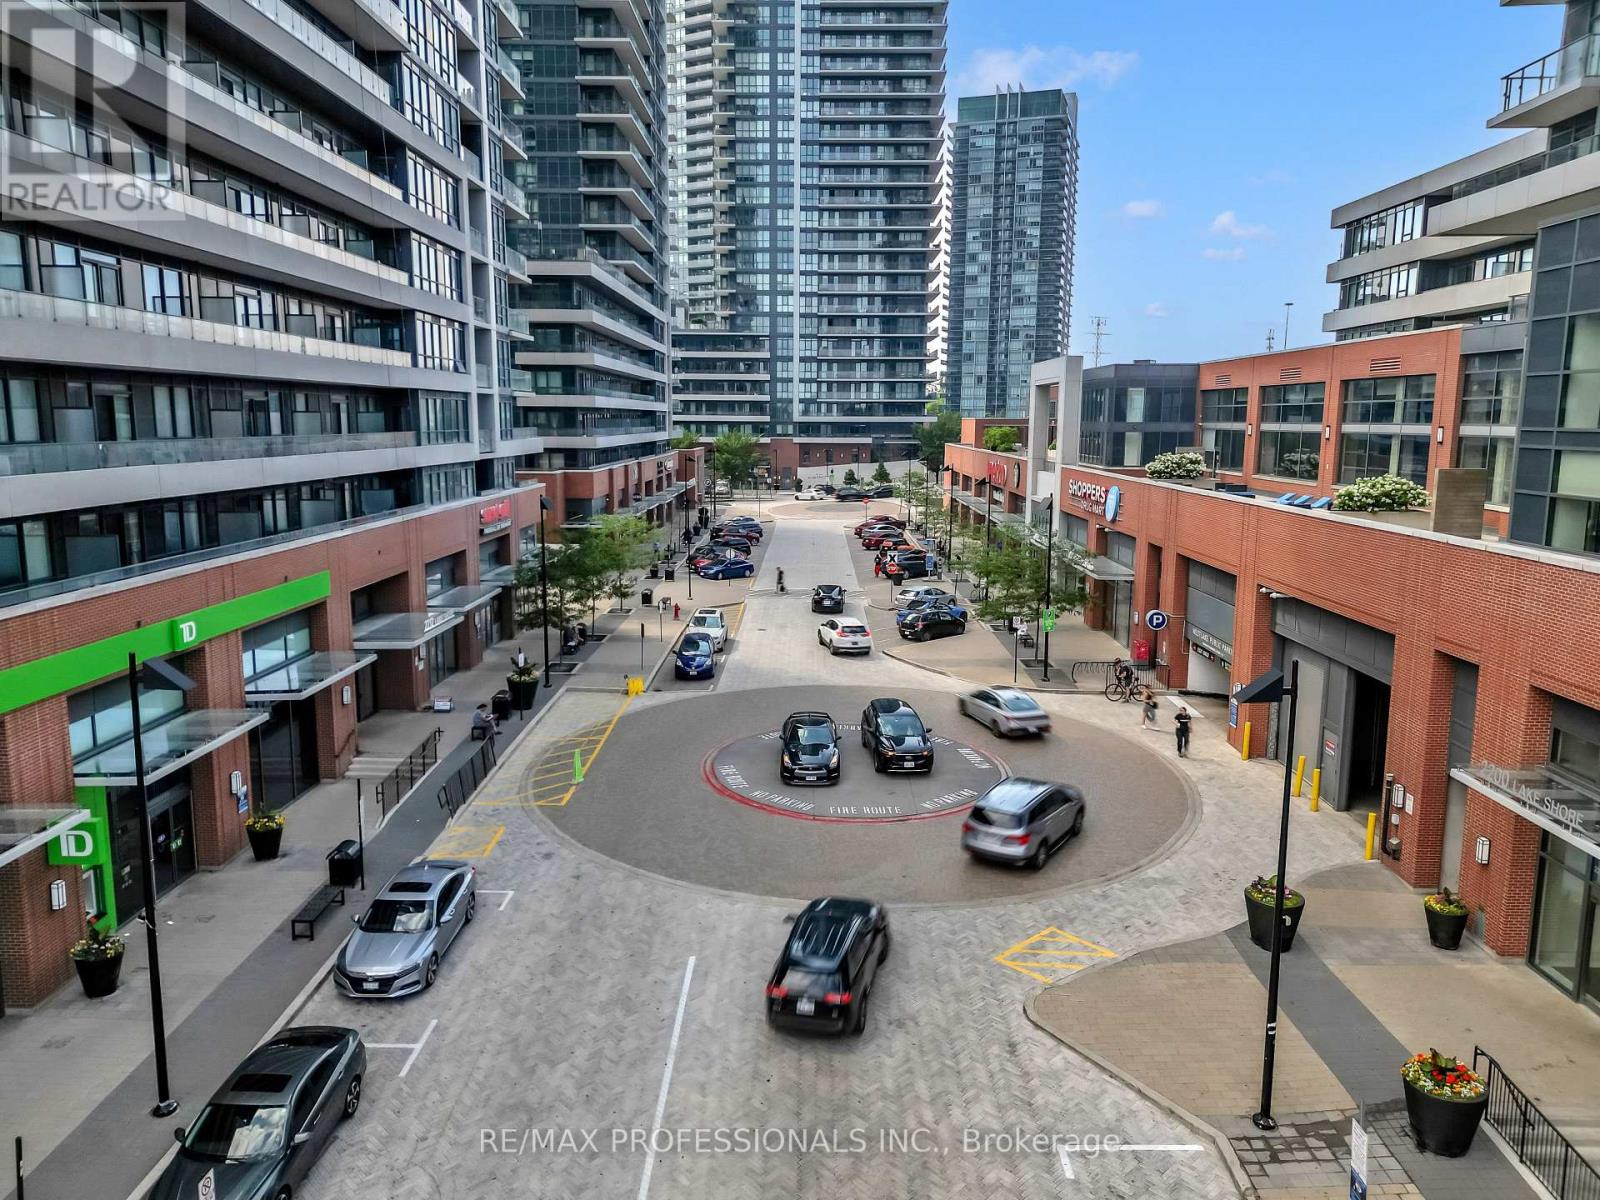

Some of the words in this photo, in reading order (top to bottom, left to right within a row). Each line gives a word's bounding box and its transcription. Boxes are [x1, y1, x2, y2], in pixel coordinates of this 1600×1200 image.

[1068, 479, 1106, 503] SHOPPERS
[1153, 614, 1163, 626] P
[180, 621, 196, 643] TD
[829, 806, 857, 815] FIRE
[863, 806, 902, 815] ROUTE
[1512, 780, 1540, 806] LAKE
[1543, 796, 1584, 827] SHORE
